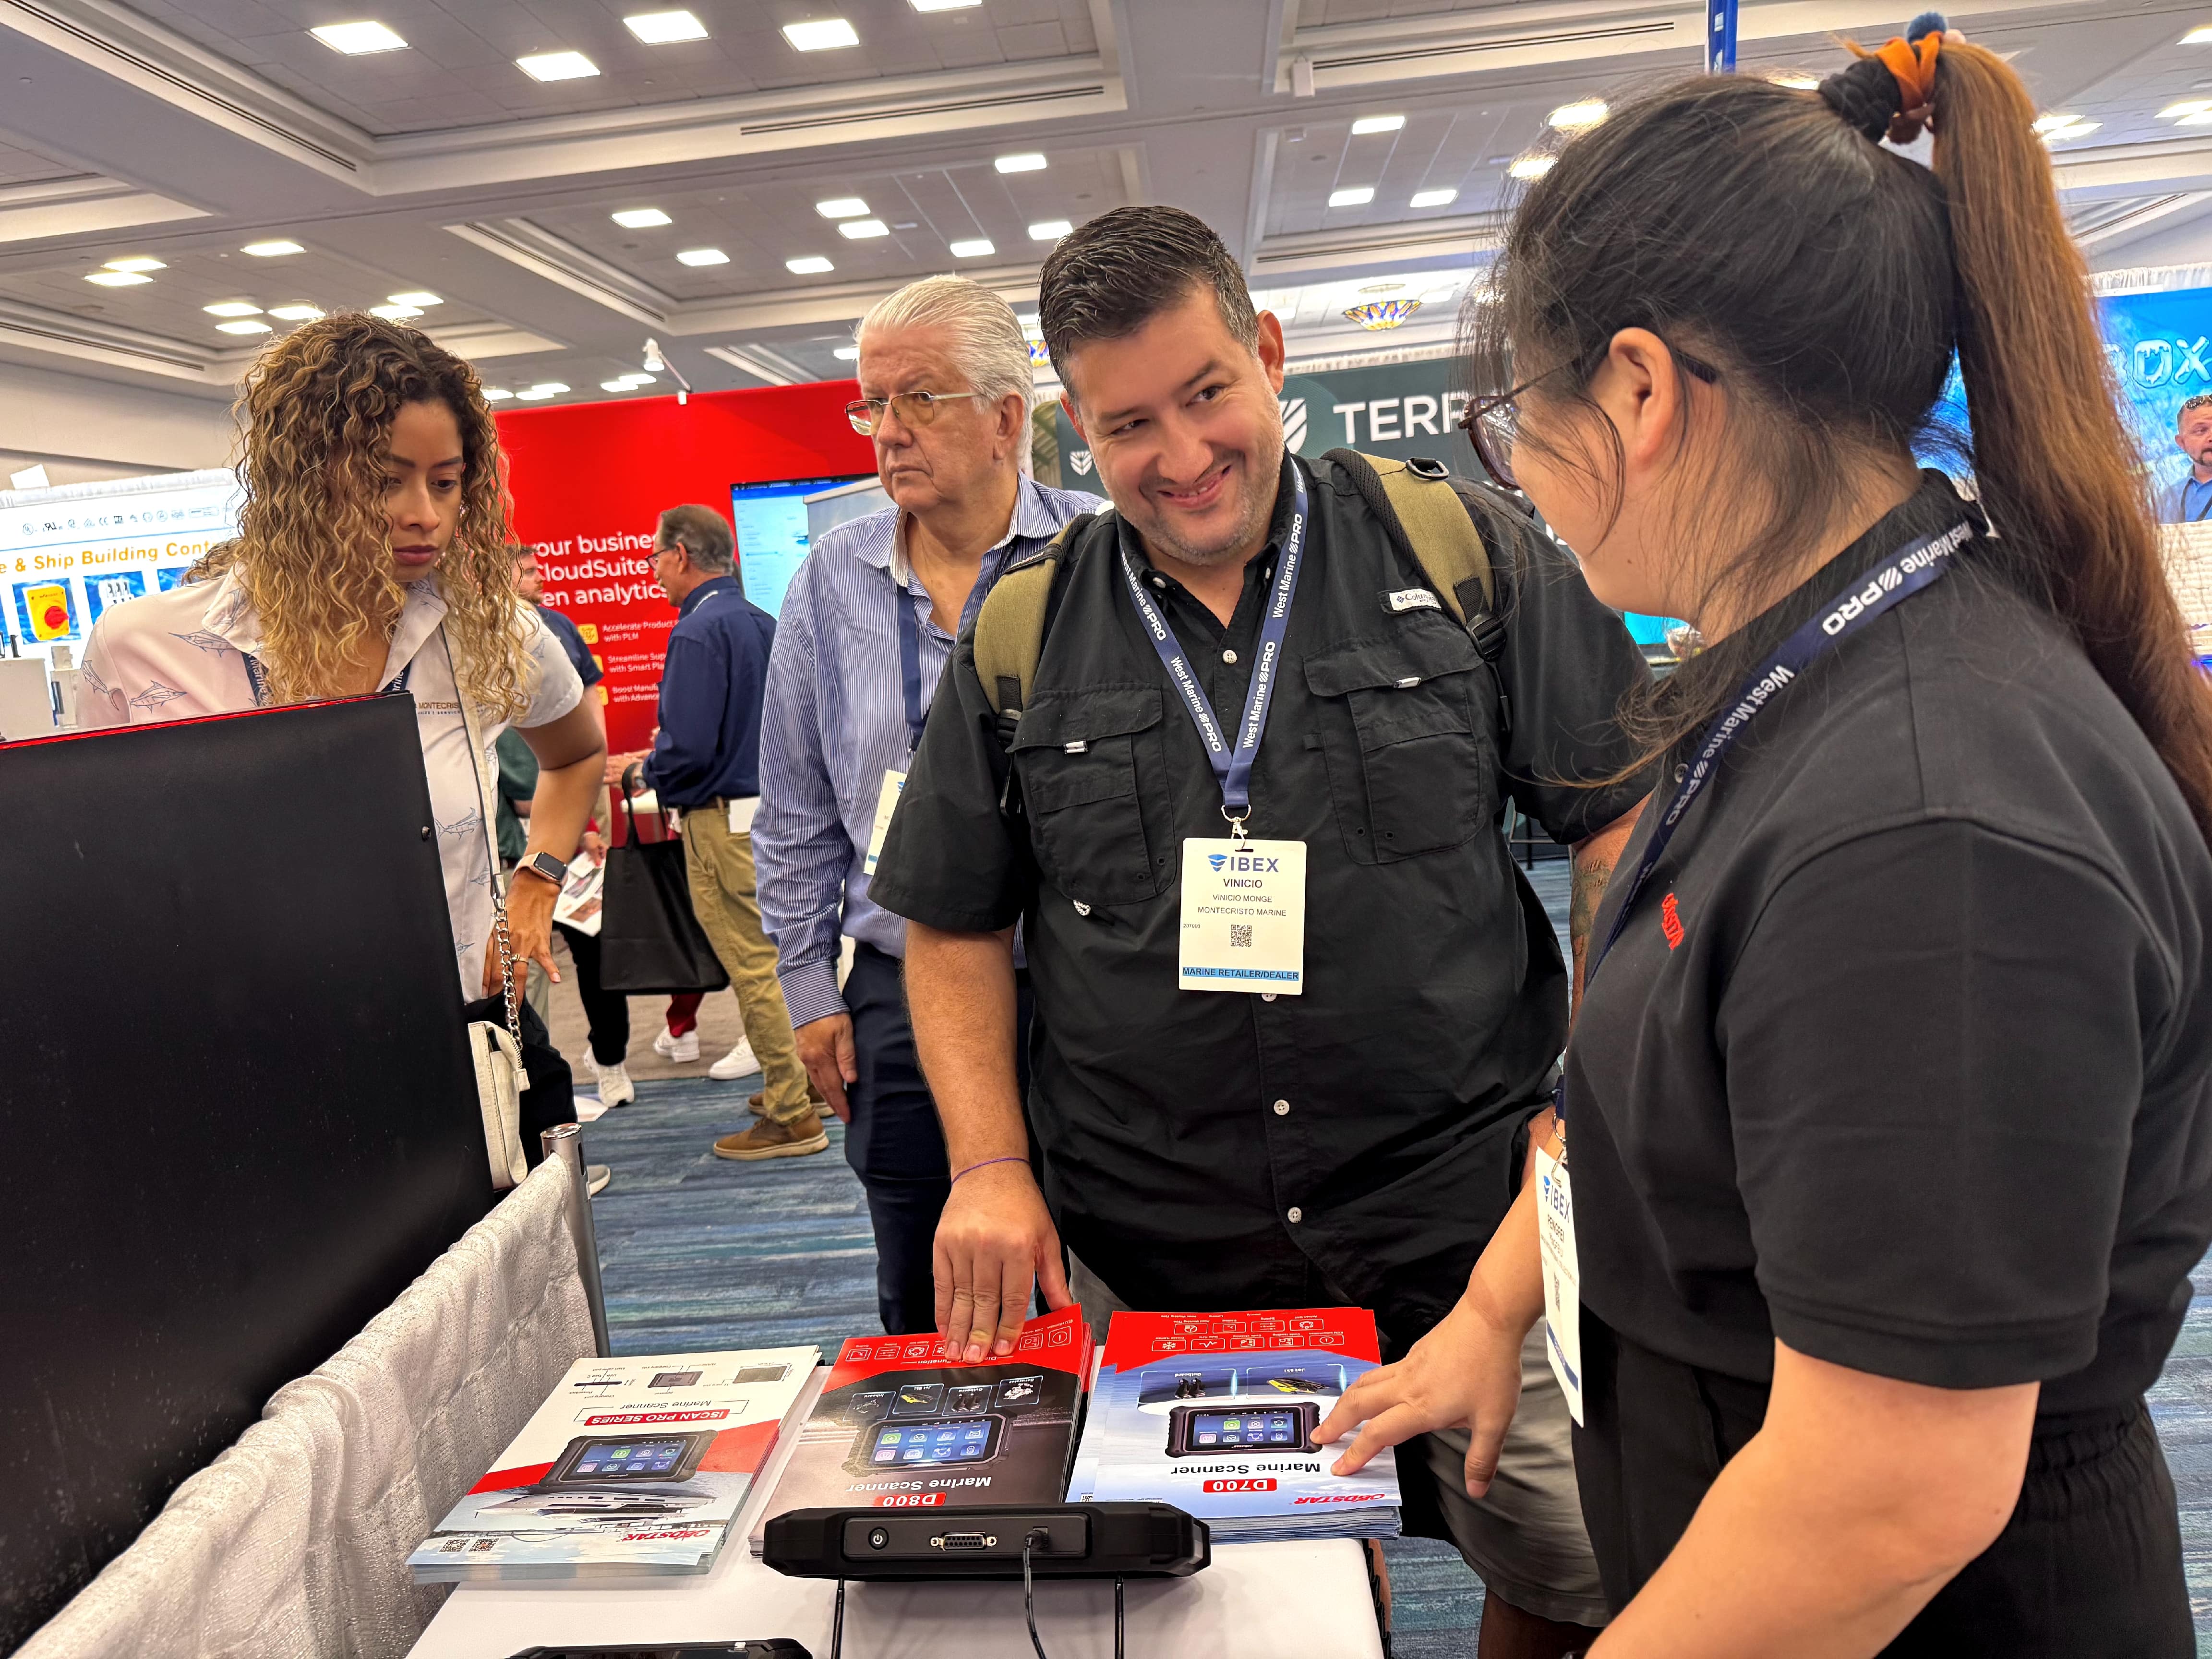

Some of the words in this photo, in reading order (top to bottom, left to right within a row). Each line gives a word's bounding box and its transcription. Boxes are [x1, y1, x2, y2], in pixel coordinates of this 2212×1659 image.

[1291, 513, 1303, 545] PRO
[1948, 520, 1974, 549] West
[534, 540, 573, 557] our
[577, 530, 656, 554] busine
[15, 557, 26, 572] &
[34, 553, 74, 570] Ship
[82, 546, 158, 565] Building
[1900, 534, 1956, 574] Marine
[1279, 554, 1297, 591] Marine
[1121, 550, 1131, 576] West
[1129, 571, 1147, 607] Marine
[1147, 612, 1166, 641] PRO
[1272, 591, 1288, 619] West
[1822, 581, 1883, 636] PRO
[602, 622, 642, 632] Accelerate
[643, 620, 675, 629] Product
[604, 633, 622, 642] with
[622, 632, 639, 641] PLM
[607, 653, 649, 663] Streamline
[609, 664, 626, 673] with
[627, 662, 651, 673] Smart
[612, 685, 633, 694] Boost
[1746, 665, 1795, 706] West
[613, 694, 630, 703] with
[1242, 722, 1259, 749] West
[1251, 683, 1267, 722] Marine
[1261, 641, 1276, 673] PRO
[1170, 656, 1189, 682] West
[1181, 679, 1204, 714] Marine
[1202, 721, 1223, 753] PRO
[1702, 702, 1757, 759] Marine
[1665, 778, 1701, 826] PRO
[1230, 856, 1279, 873] IBEX
[1223, 878, 1262, 888] VINICIO
[1198, 906, 1254, 915] MONTECRISTO
[1256, 908, 1286, 916] MARINE
[1182, 967, 1218, 976] MARINE
[1218, 969, 1299, 980] RETAILER/DEALER
[1551, 1184, 1571, 1224] IBEX
[590, 1414, 643, 1424] SERIES
[646, 1413, 677, 1422] PRO
[1170, 1464, 1249, 1476] Scanner
[1256, 1463, 1321, 1473] Marine
[845, 1479, 924, 1492] Scanner
[929, 1476, 992, 1489] Marine
[1212, 1479, 1268, 1491] D700
[882, 1494, 937, 1507] D800
[1294, 1494, 1385, 1504] OBDSTAR
